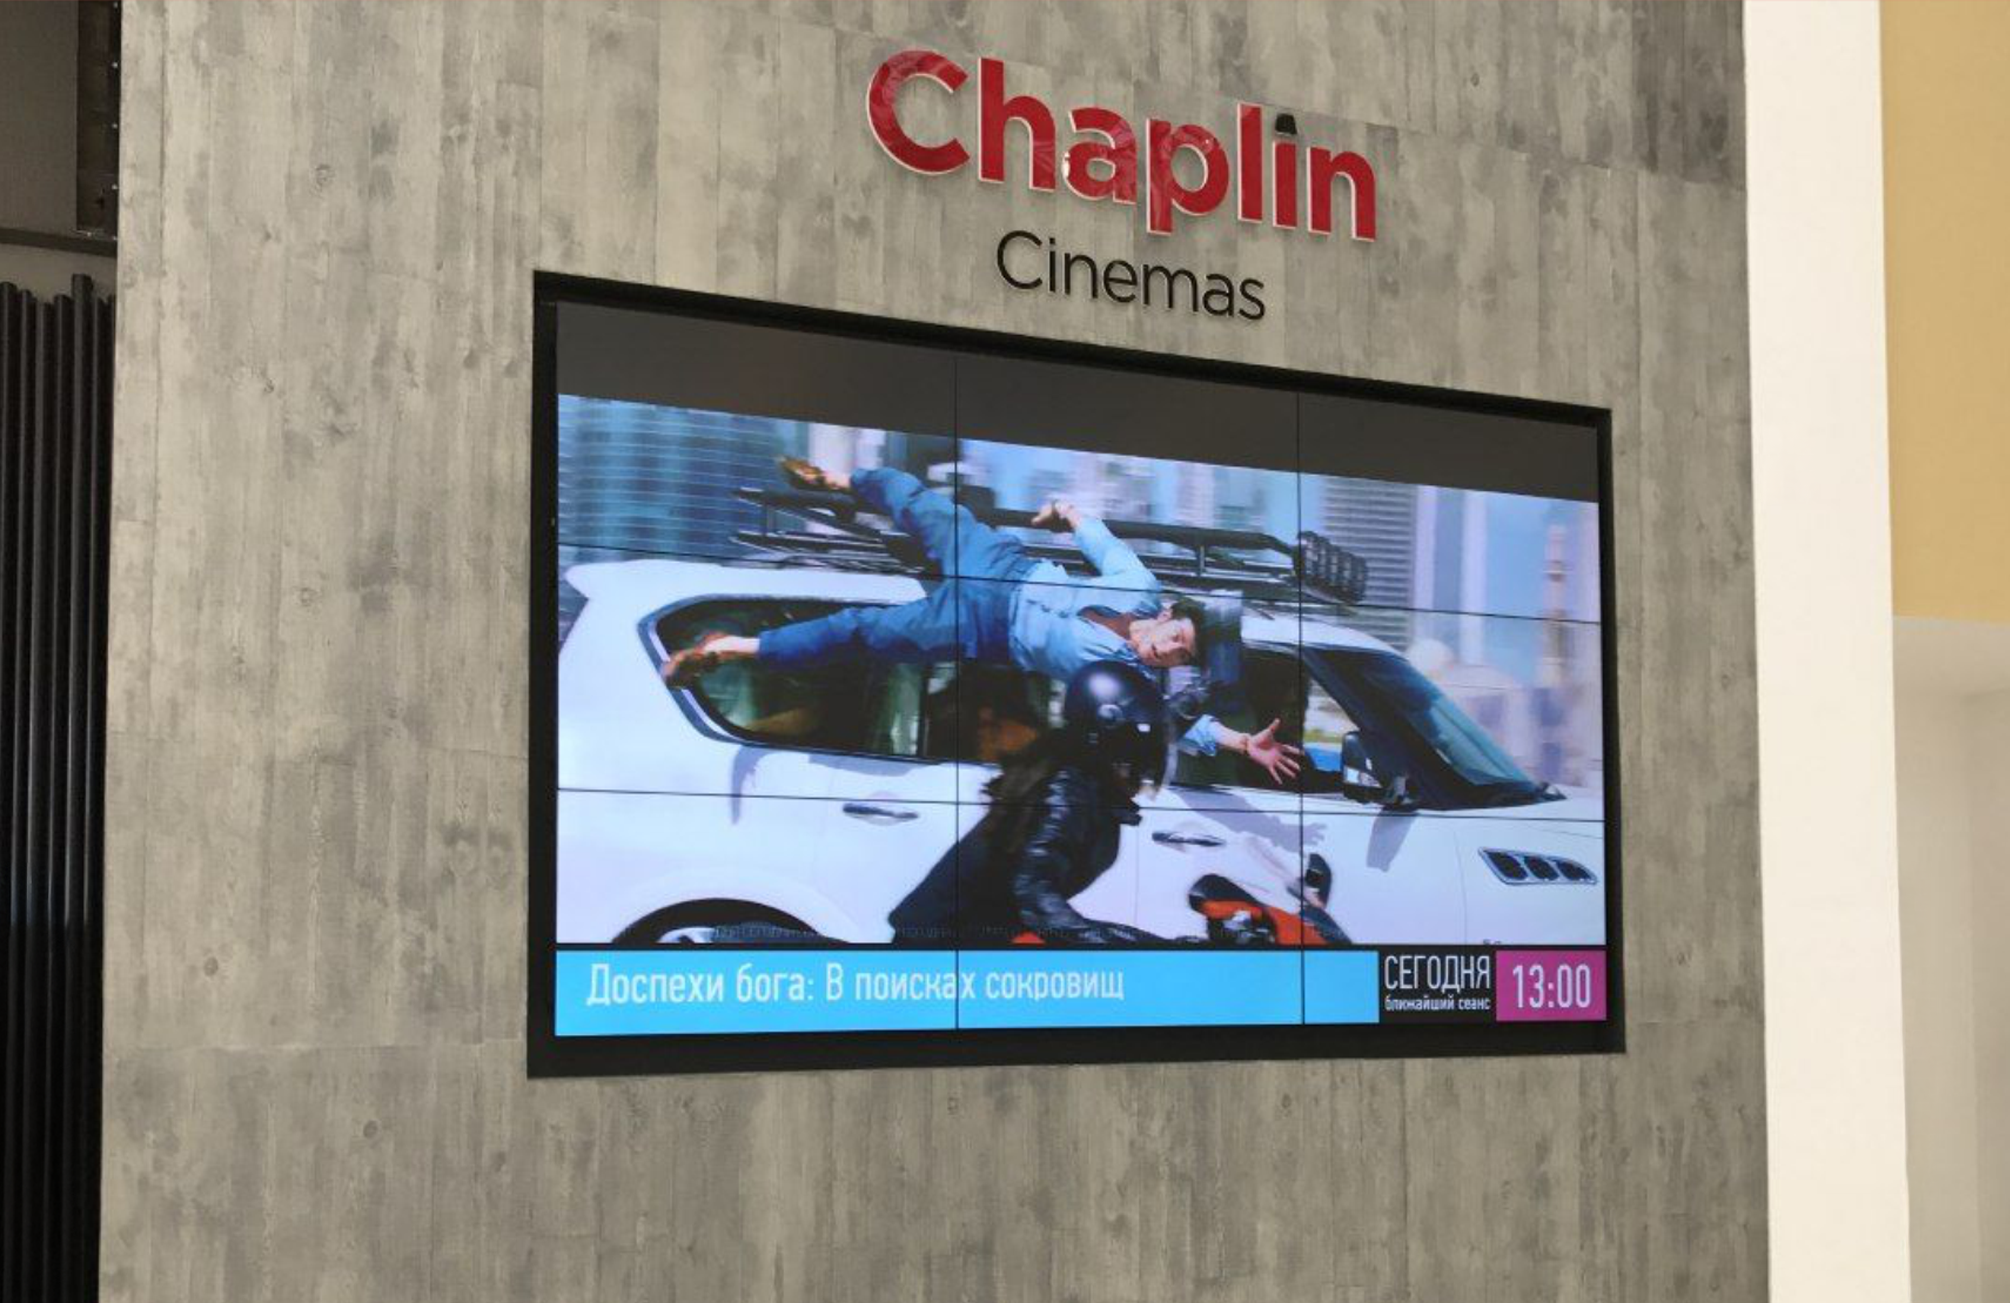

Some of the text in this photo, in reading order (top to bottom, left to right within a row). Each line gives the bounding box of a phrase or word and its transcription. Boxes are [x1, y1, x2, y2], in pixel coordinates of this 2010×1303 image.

[867, 49, 1377, 242] Chaplin
[996, 230, 1266, 321] Cinemas
[586, 962, 1125, 1005] Доспехи бога: В поисках сокровищ
[1384, 954, 1491, 994] СЕГОДНЯ
[1512, 963, 1592, 1009] 13:00
[1384, 994, 1491, 1011] ближайший сеанс
